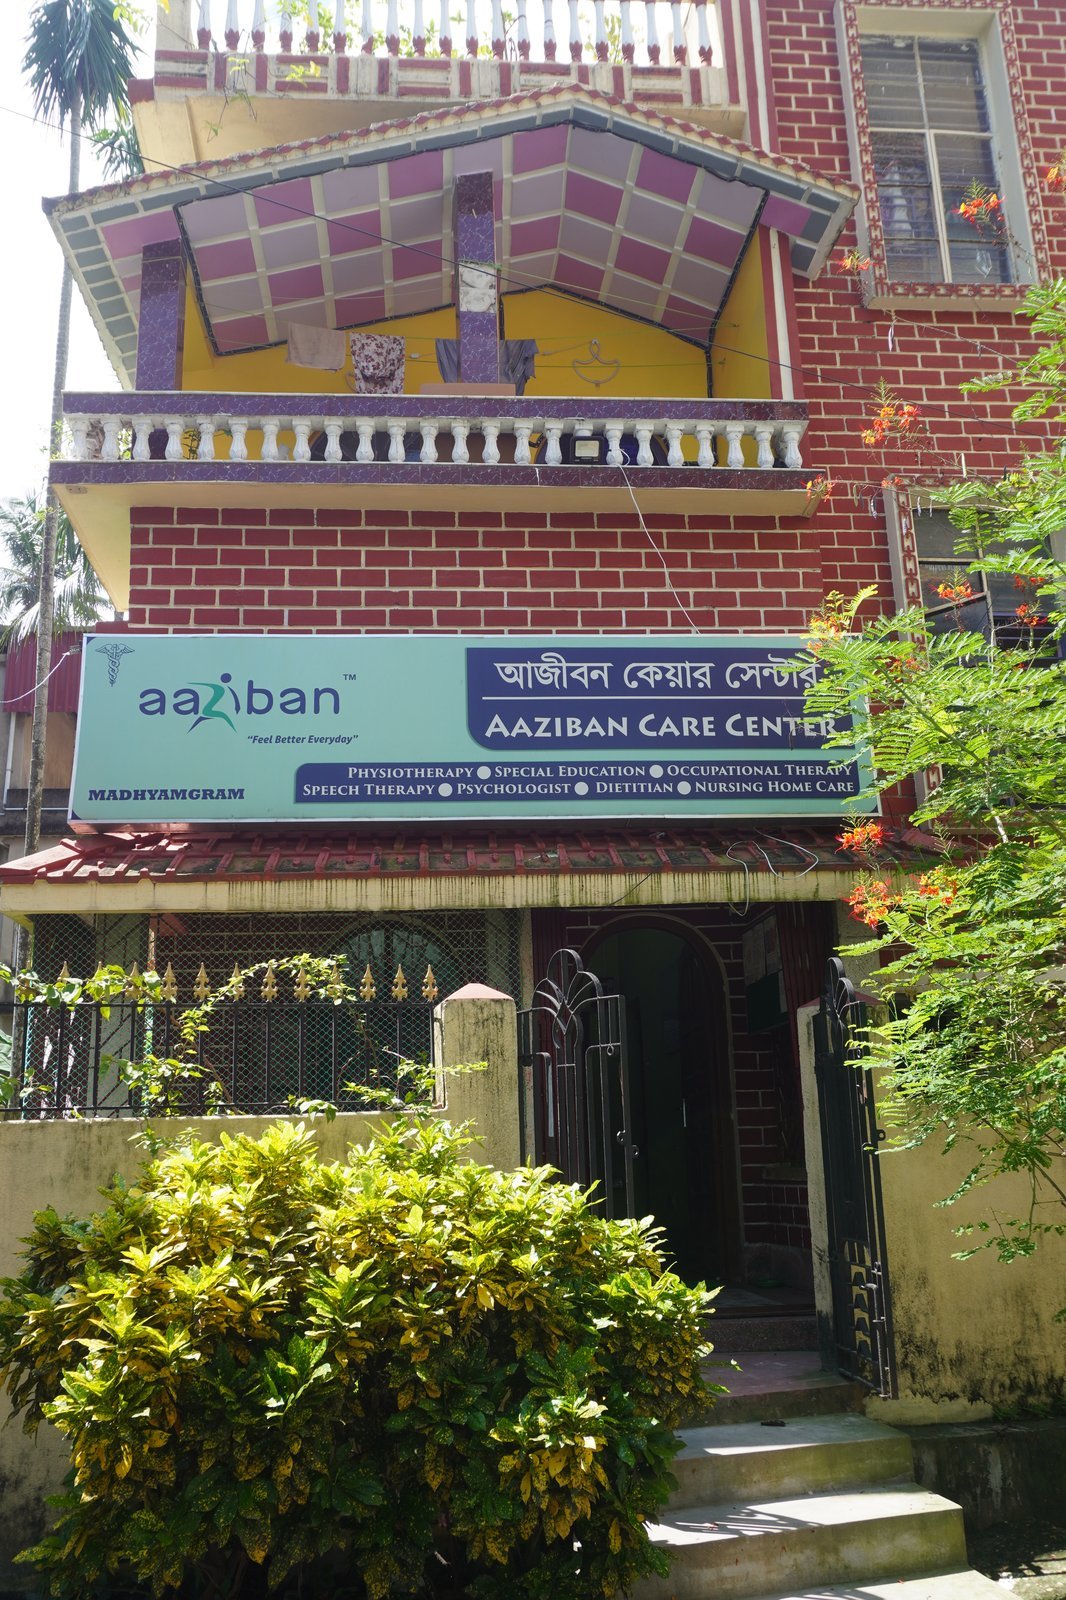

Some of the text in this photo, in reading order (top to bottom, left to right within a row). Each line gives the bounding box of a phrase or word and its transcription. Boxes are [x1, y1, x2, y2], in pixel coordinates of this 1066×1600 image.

[494, 651, 614, 690] আজীবন
[623, 660, 715, 690] কেয়ার
[485, 712, 837, 738] AAZIBAN CARE CENTER
[275, 734, 306, 744] Better
[347, 764, 853, 779] PHYSIOTHERAPY SPECIAL EDUCATION OCCUPATIONAL THERAPY
[88, 788, 246, 801] MADHYAMGRAM
[303, 780, 855, 796] SPEECH THERAPY PSYCHOLOGIST DIETITIAN NURSING HOME CARE
